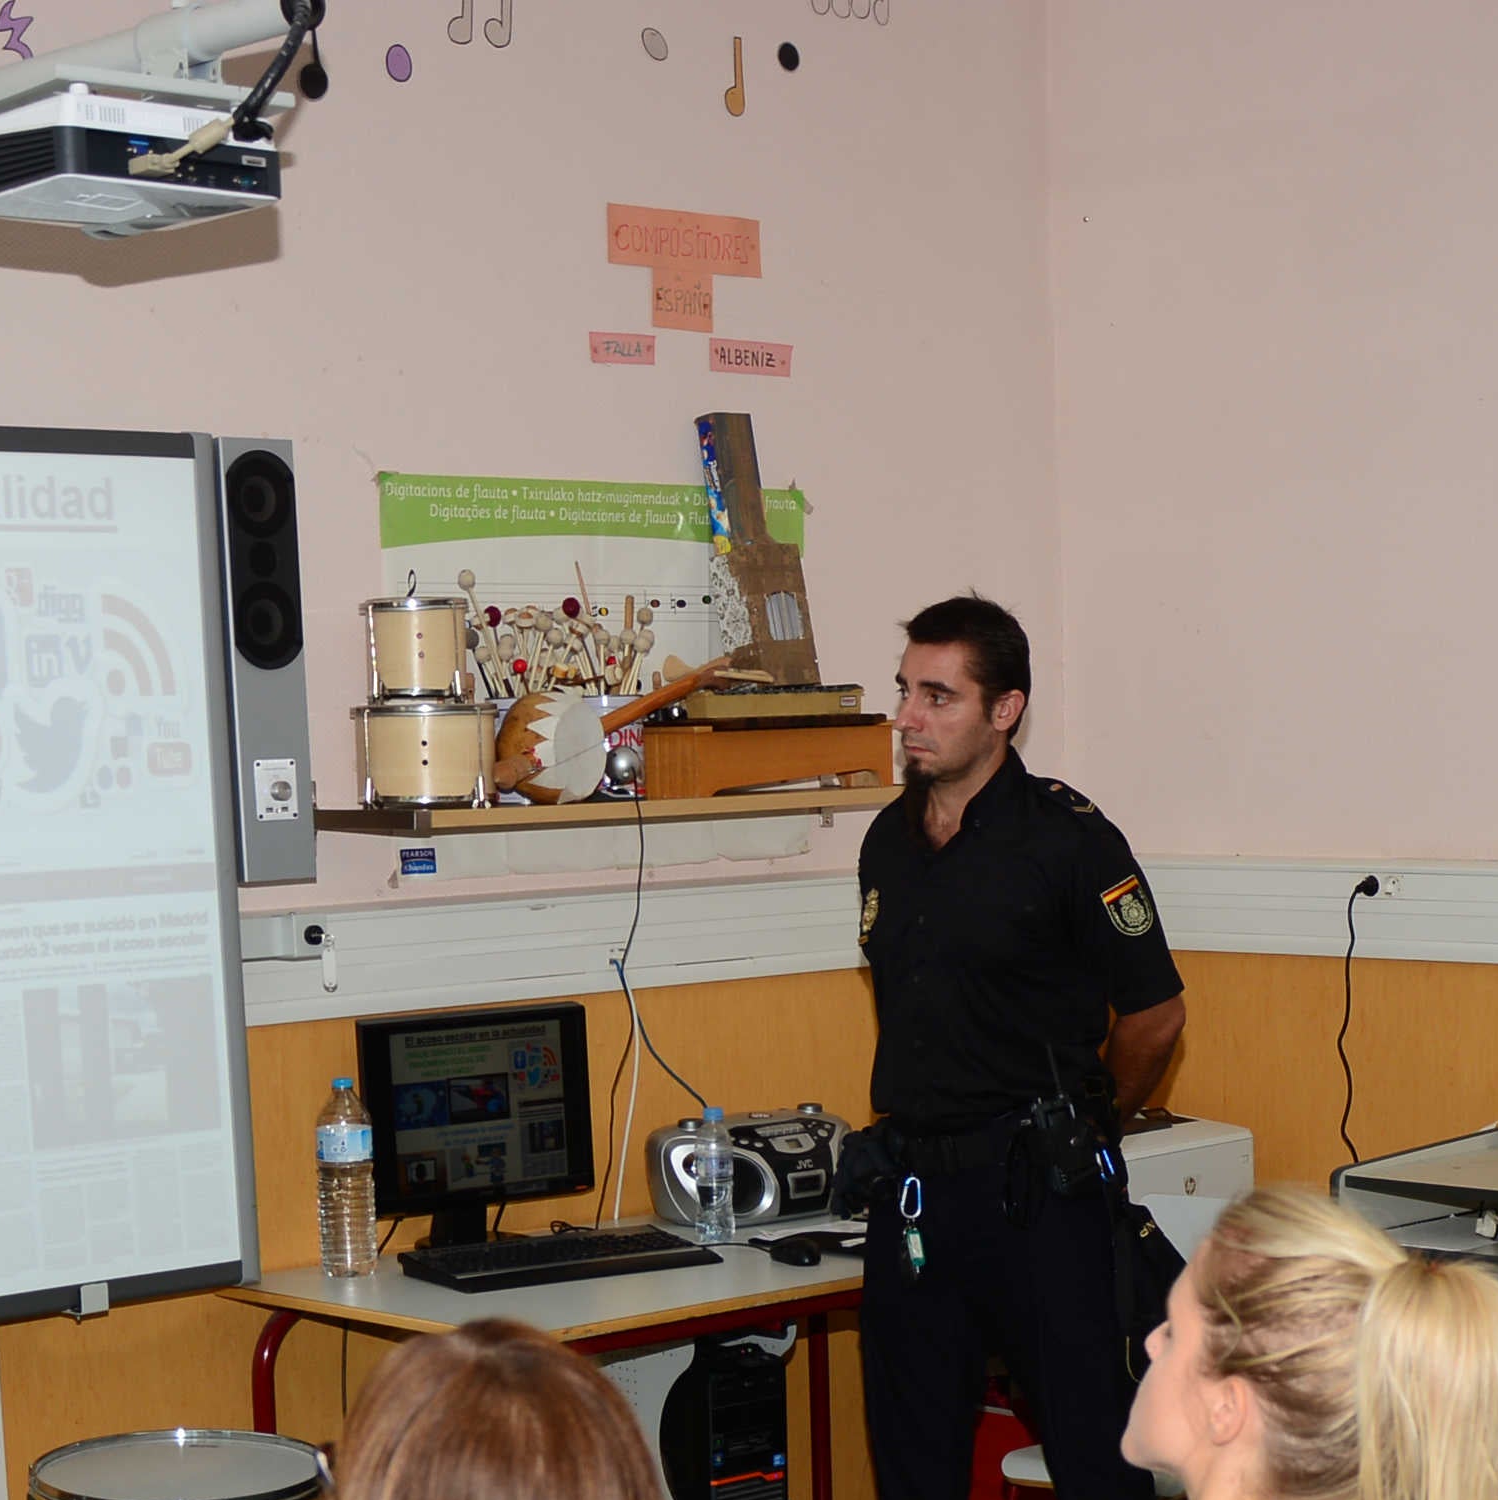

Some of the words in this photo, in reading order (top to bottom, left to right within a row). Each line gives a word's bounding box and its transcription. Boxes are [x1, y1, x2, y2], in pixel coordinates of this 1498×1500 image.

[655, 280, 712, 320] ESPAÑA
[719, 345, 776, 368] ALBENIZ
[384, 482, 453, 504] Digitacions
[455, 484, 470, 498] de
[472, 484, 509, 502] flauta
[521, 486, 575, 503] Txirulako
[577, 488, 681, 508] hatz-mugimenduak
[429, 503, 491, 519] Digitações
[493, 504, 509, 519] de
[512, 505, 547, 522] flauta
[558, 508, 626, 524] Digitaciones
[629, 511, 643, 523] de
[644, 508, 677, 525] flauta
[796, 1158, 814, 1170] JVC
